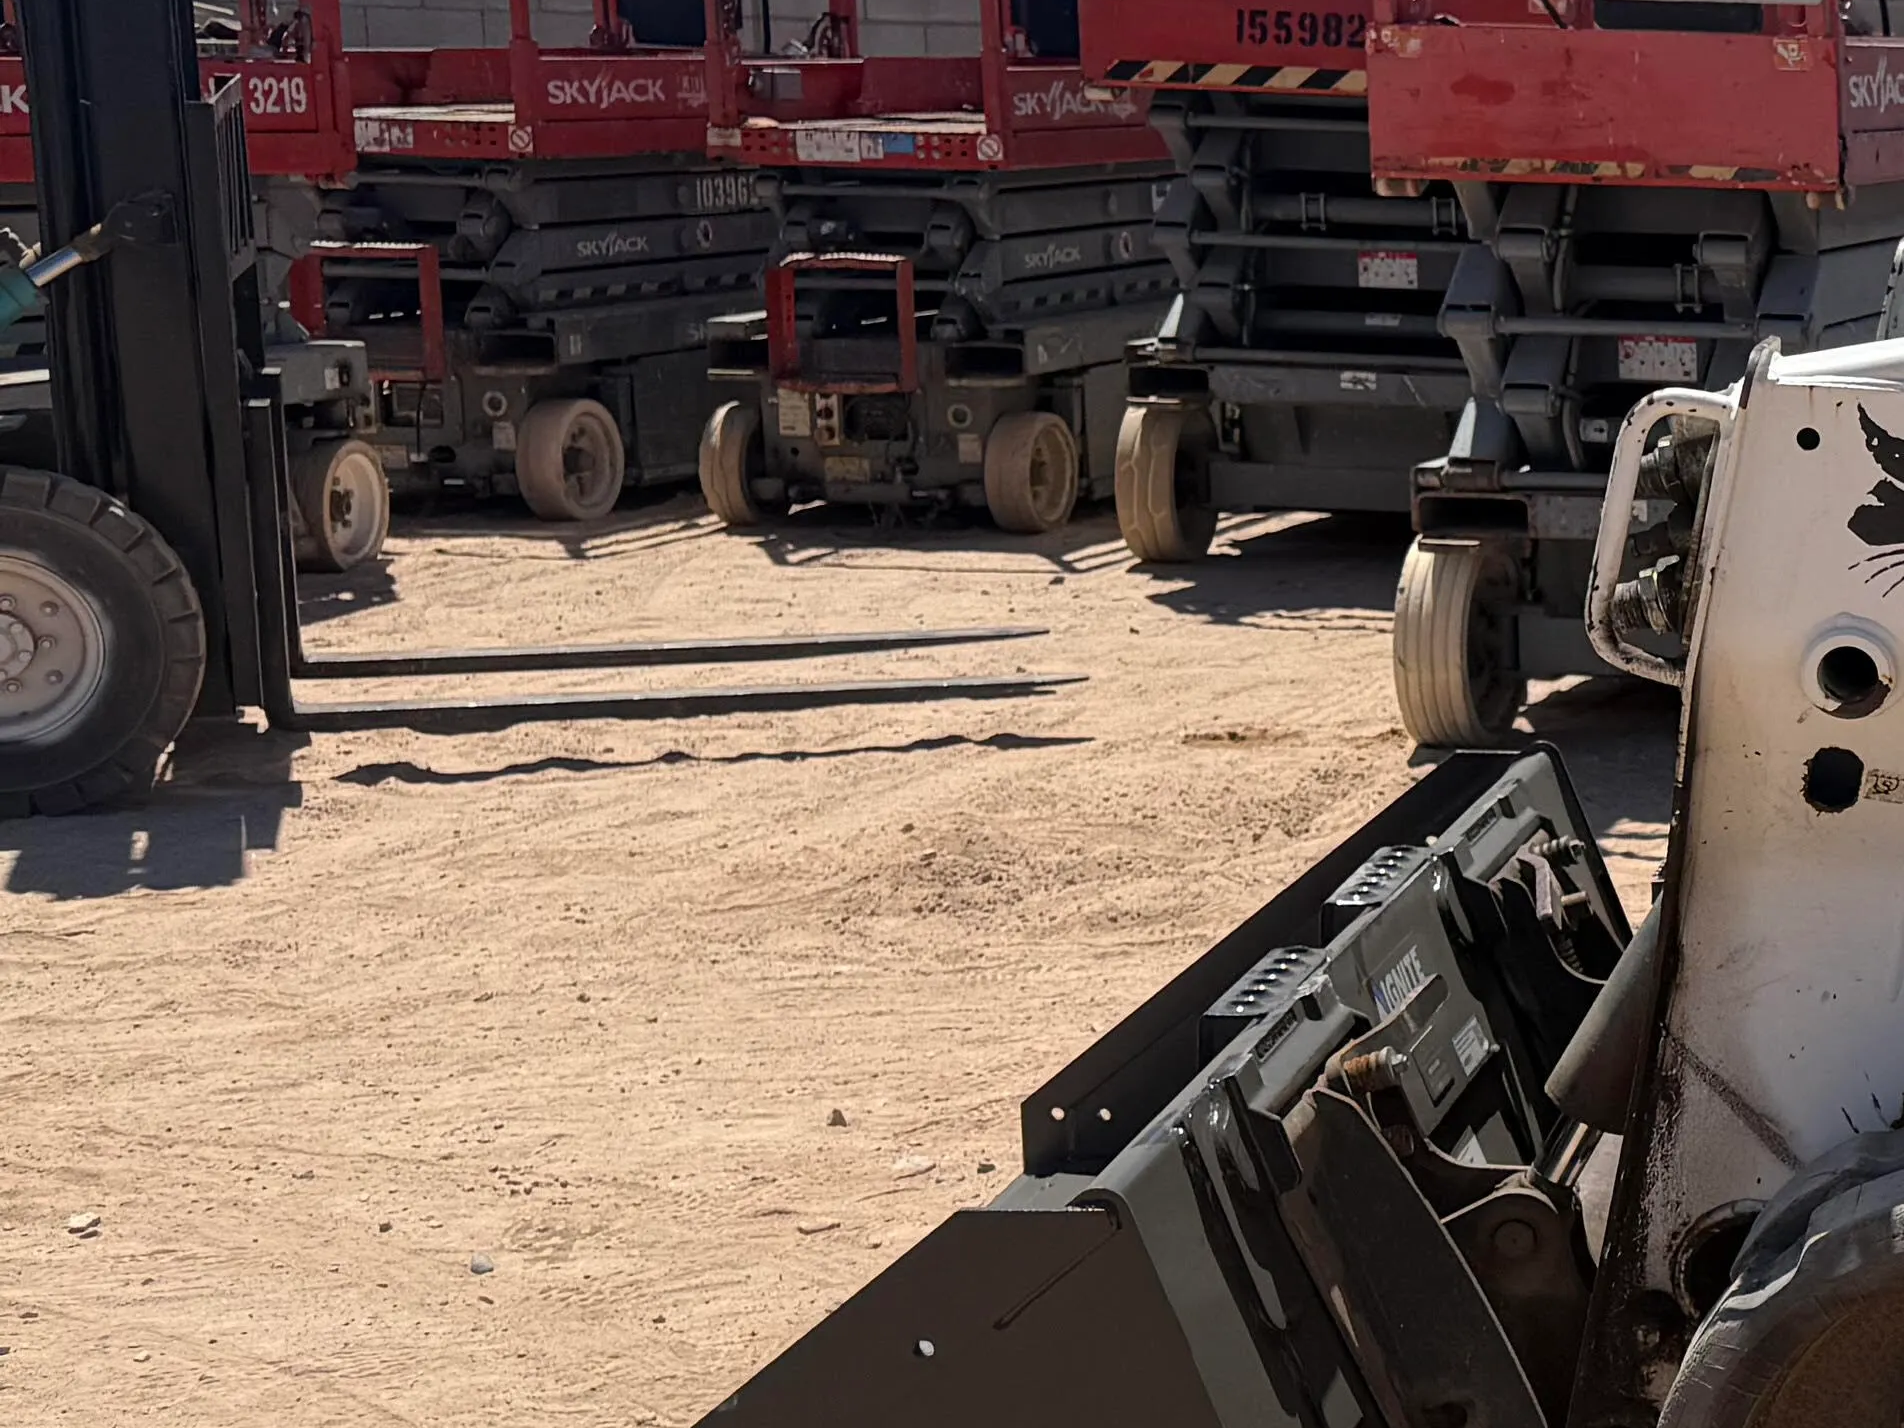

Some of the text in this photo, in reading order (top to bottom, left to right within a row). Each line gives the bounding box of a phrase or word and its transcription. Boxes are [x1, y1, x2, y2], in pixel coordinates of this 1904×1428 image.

[1236, 8, 1367, 49] 155982
[248, 76, 308, 115] 3219
[546, 70, 666, 110] SKYJACK
[577, 229, 649, 257] SKYJACK
[1379, 943, 1427, 1015] IGNITE
